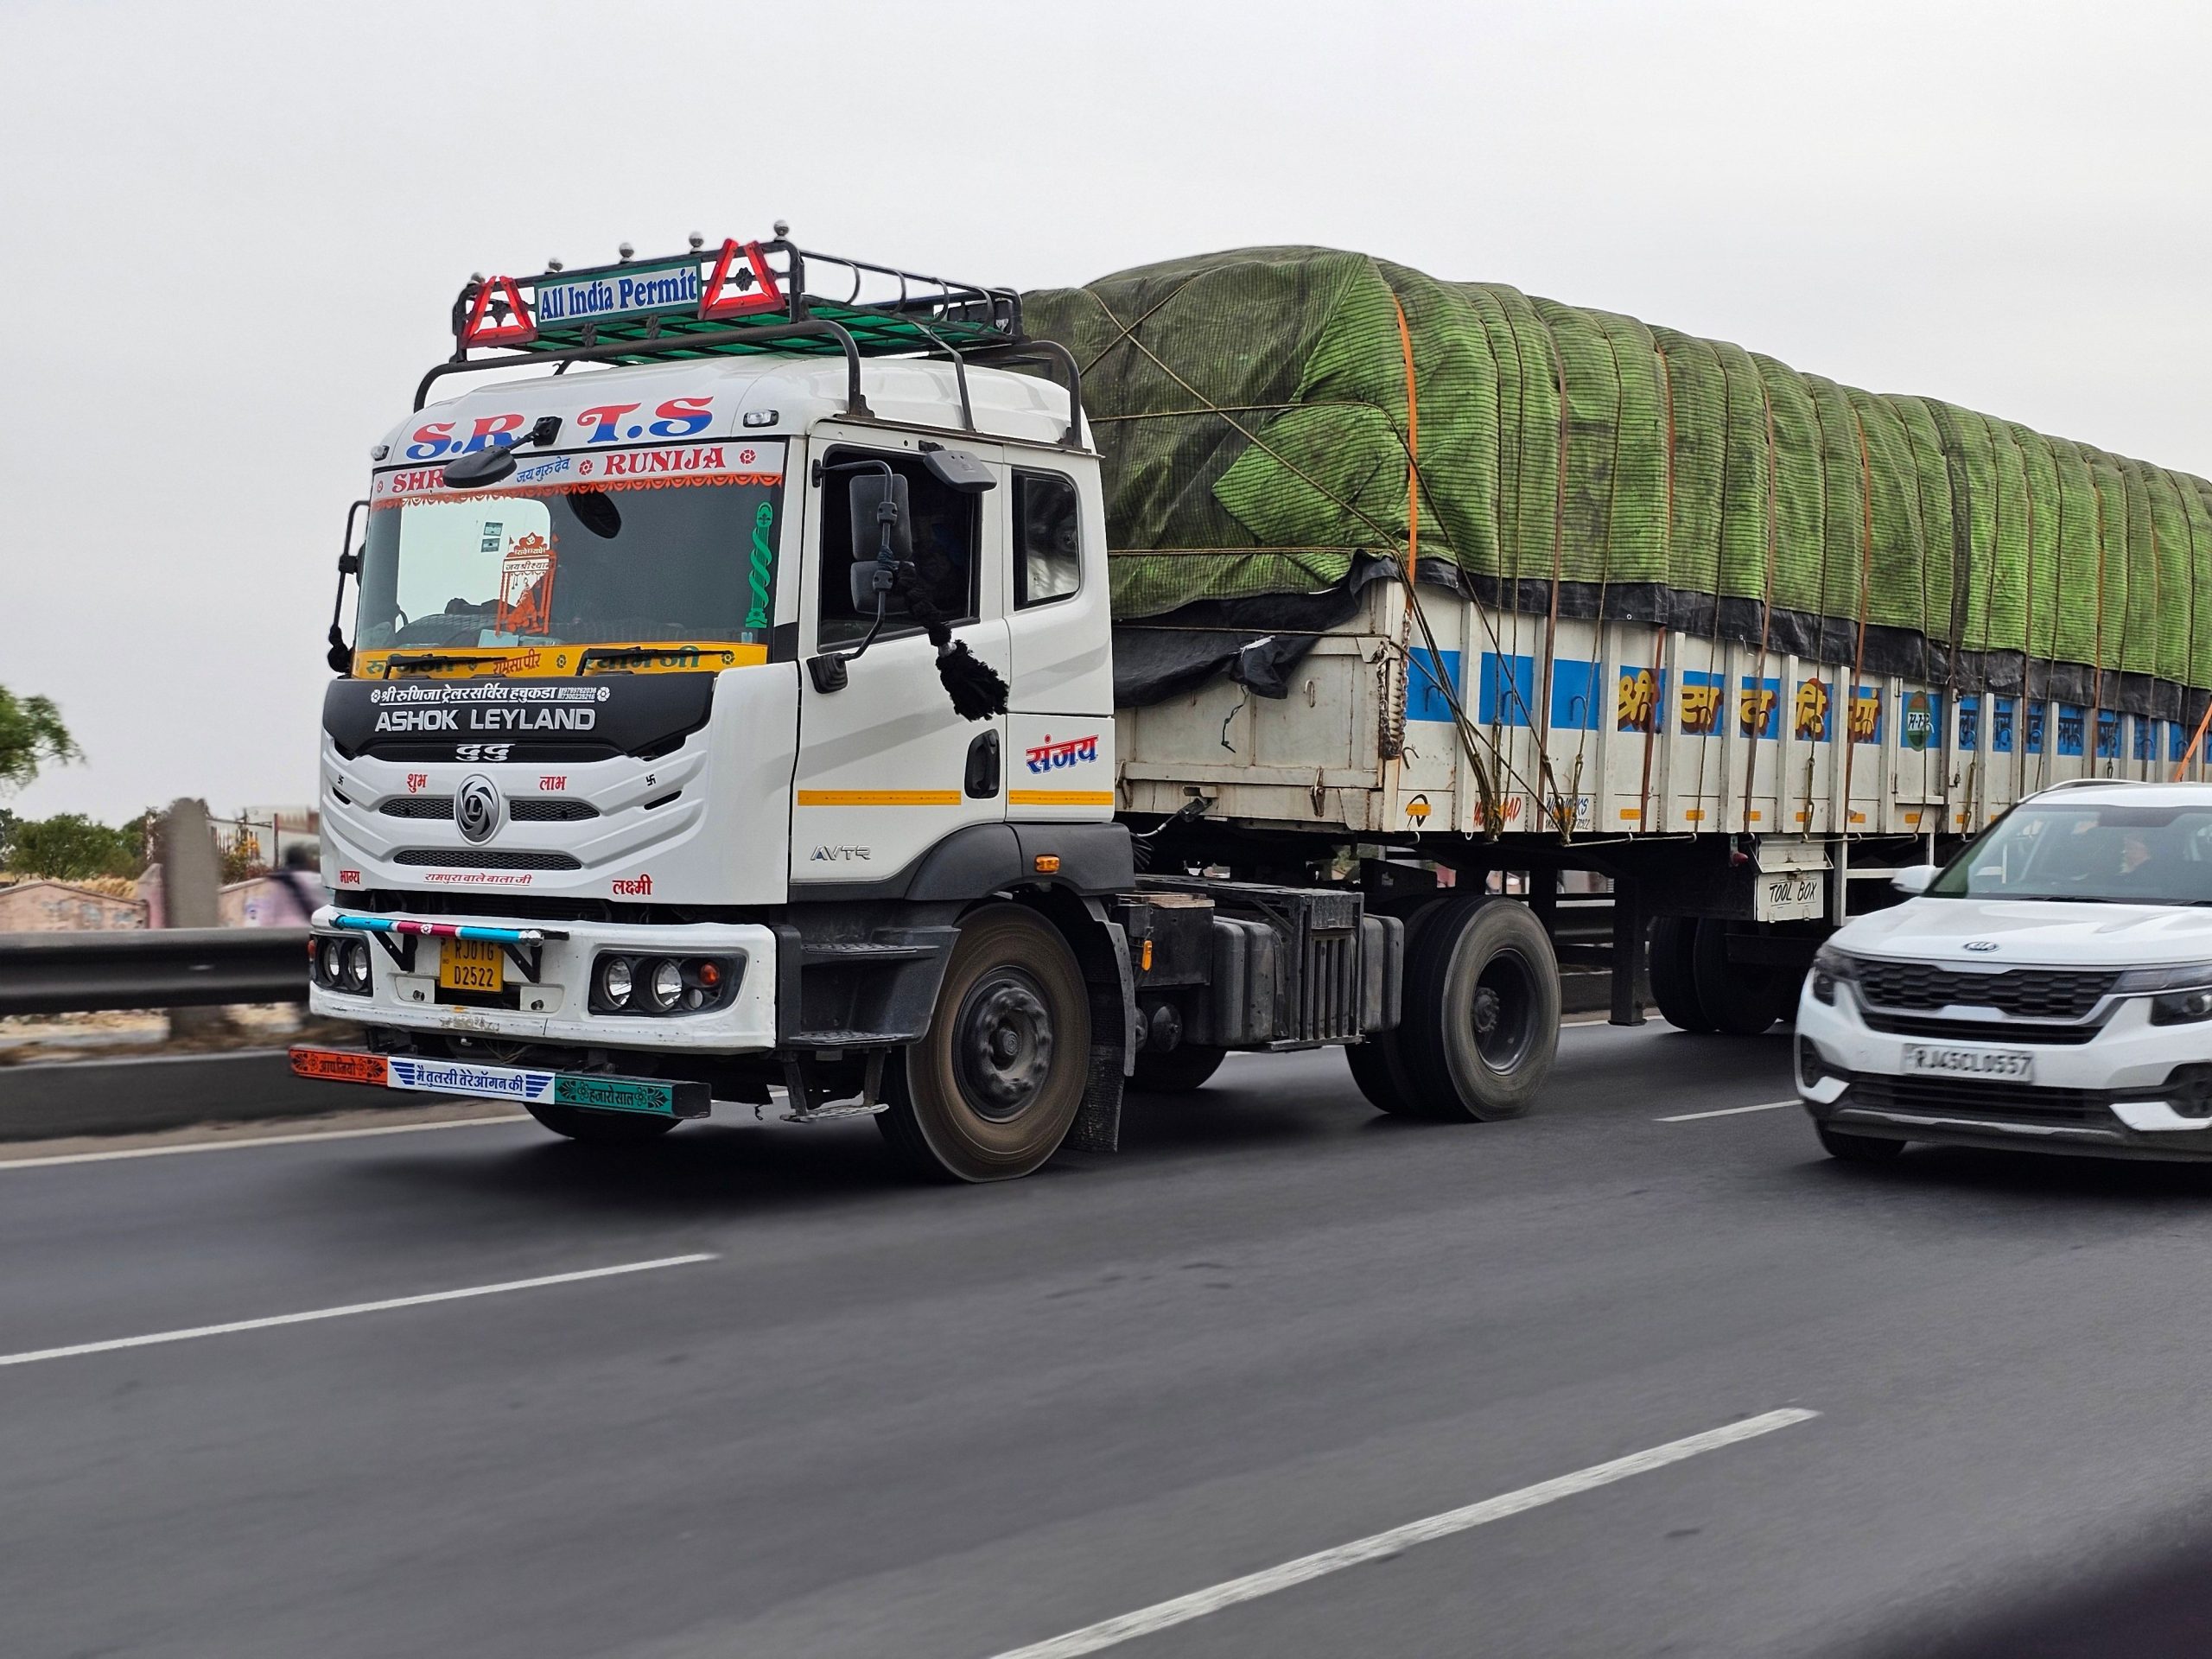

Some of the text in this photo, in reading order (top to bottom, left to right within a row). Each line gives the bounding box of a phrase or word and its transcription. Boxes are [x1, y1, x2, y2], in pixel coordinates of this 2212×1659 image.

[541, 269, 696, 320] All India Permit
[577, 396, 714, 443] T.S
[517, 468, 535, 482] जय
[555, 456, 571, 473] देव
[604, 447, 726, 475] RUNIJA
[392, 468, 447, 493] SHR
[375, 709, 595, 731] ASHOK LEYLAND
[1026, 734, 1099, 774] संजय
[407, 773, 567, 792] शुभ लाभ
[810, 845, 872, 861] AVTR
[612, 874, 653, 895] लक्ष्मी
[1770, 880, 1818, 902] TOOL BOX
[454, 965, 493, 987] D2522
[426, 1068, 458, 1087] तुलसी
[459, 1069, 474, 1086] तेरे
[508, 1074, 524, 1091] की
